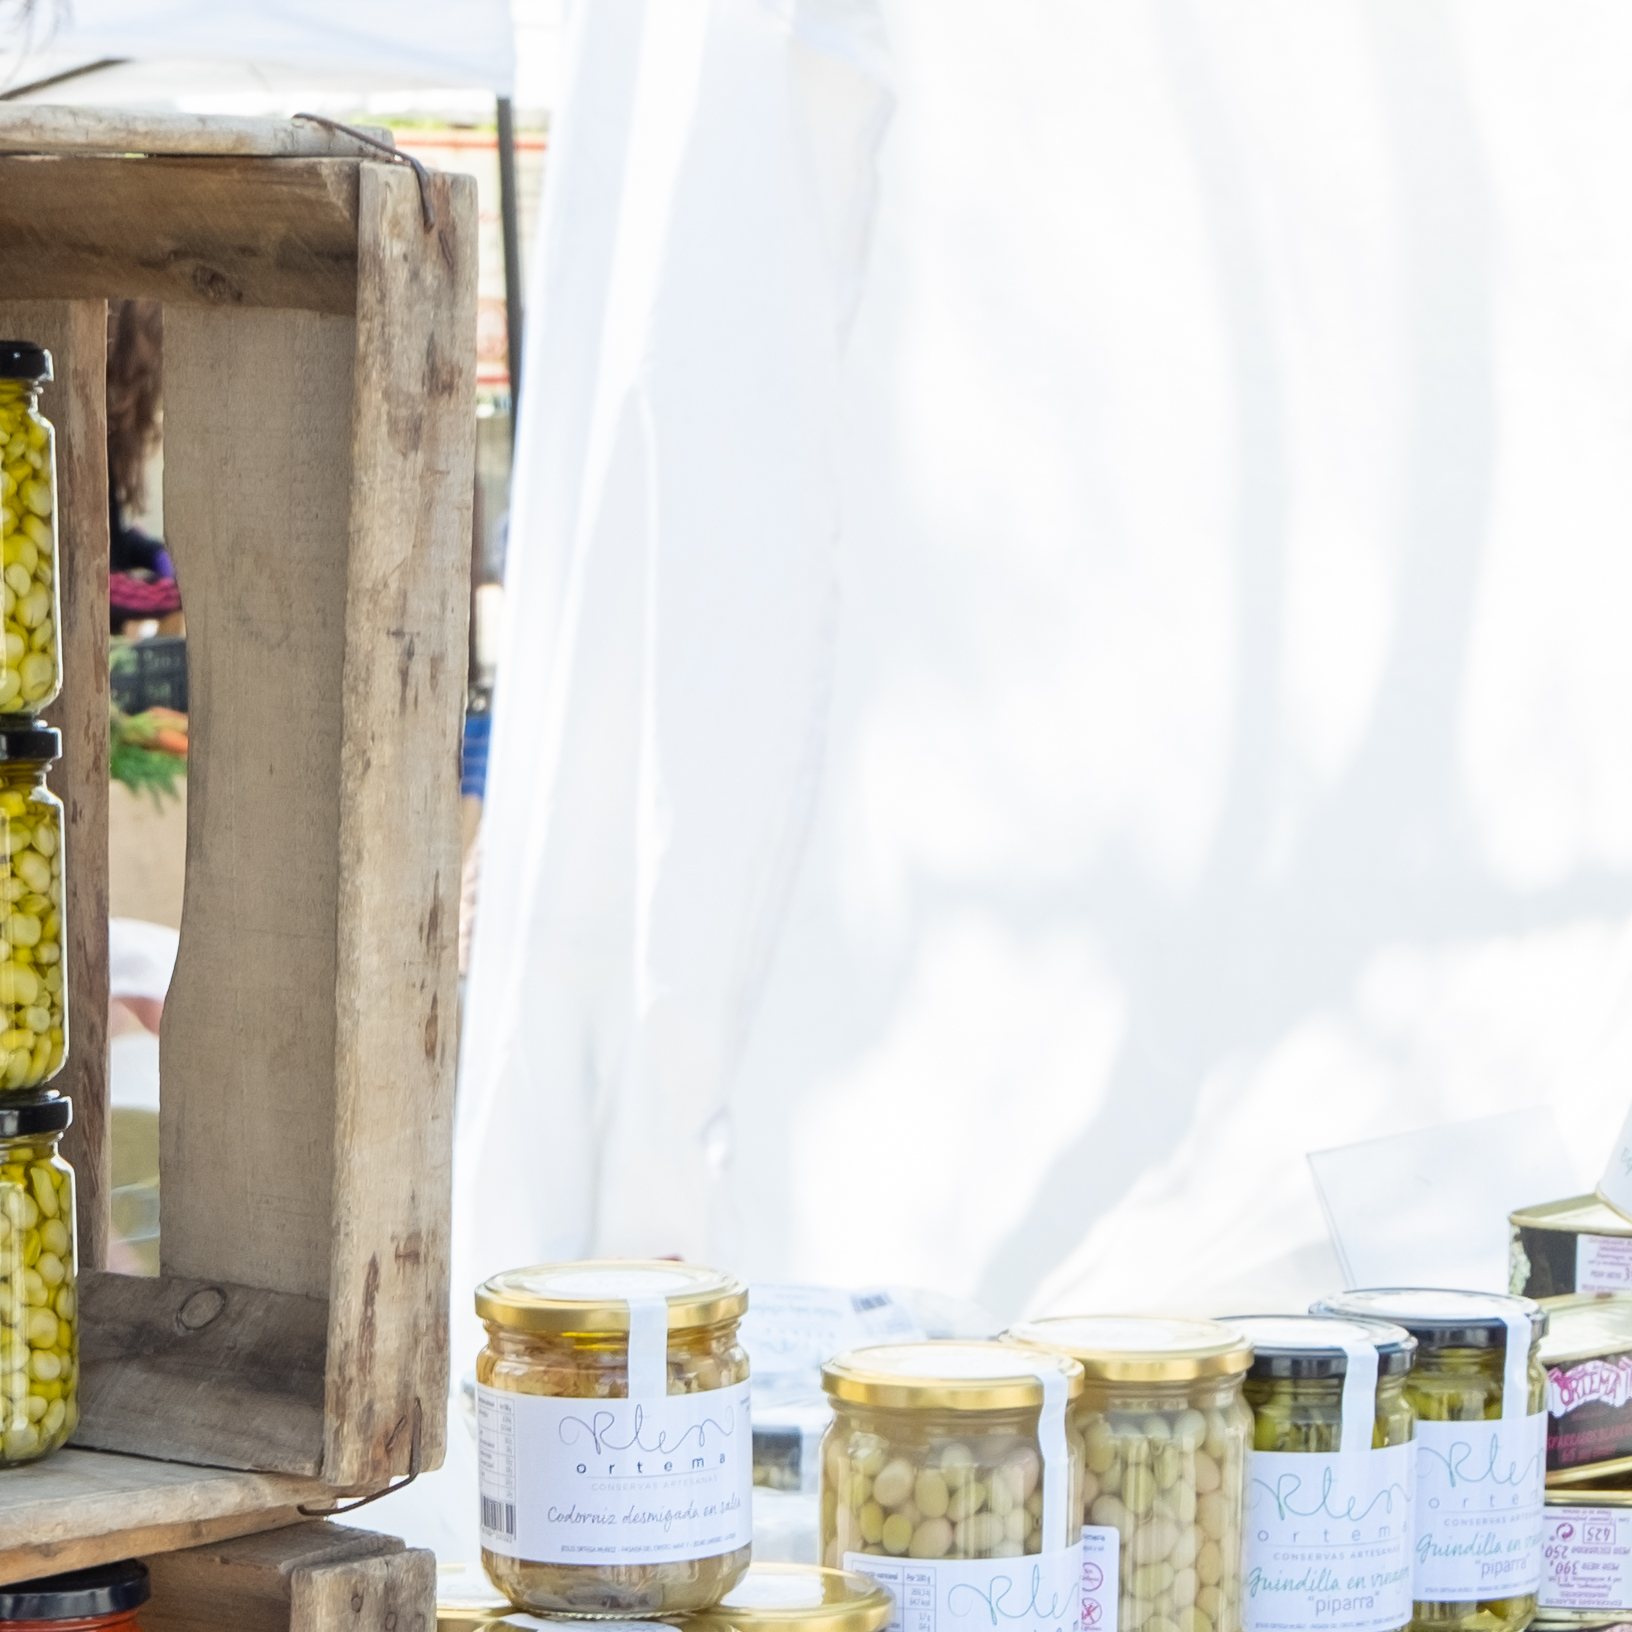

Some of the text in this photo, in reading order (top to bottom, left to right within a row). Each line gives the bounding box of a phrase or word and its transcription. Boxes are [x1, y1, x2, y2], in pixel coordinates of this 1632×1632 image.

[576, 1452, 726, 1474] ortema
[547, 1505, 617, 1524] Codorniz
[621, 1499, 700, 1533] desmigada
[1273, 1552, 1345, 1561] CONSERVAS
[1249, 1566, 1367, 1598] Guindilla en
